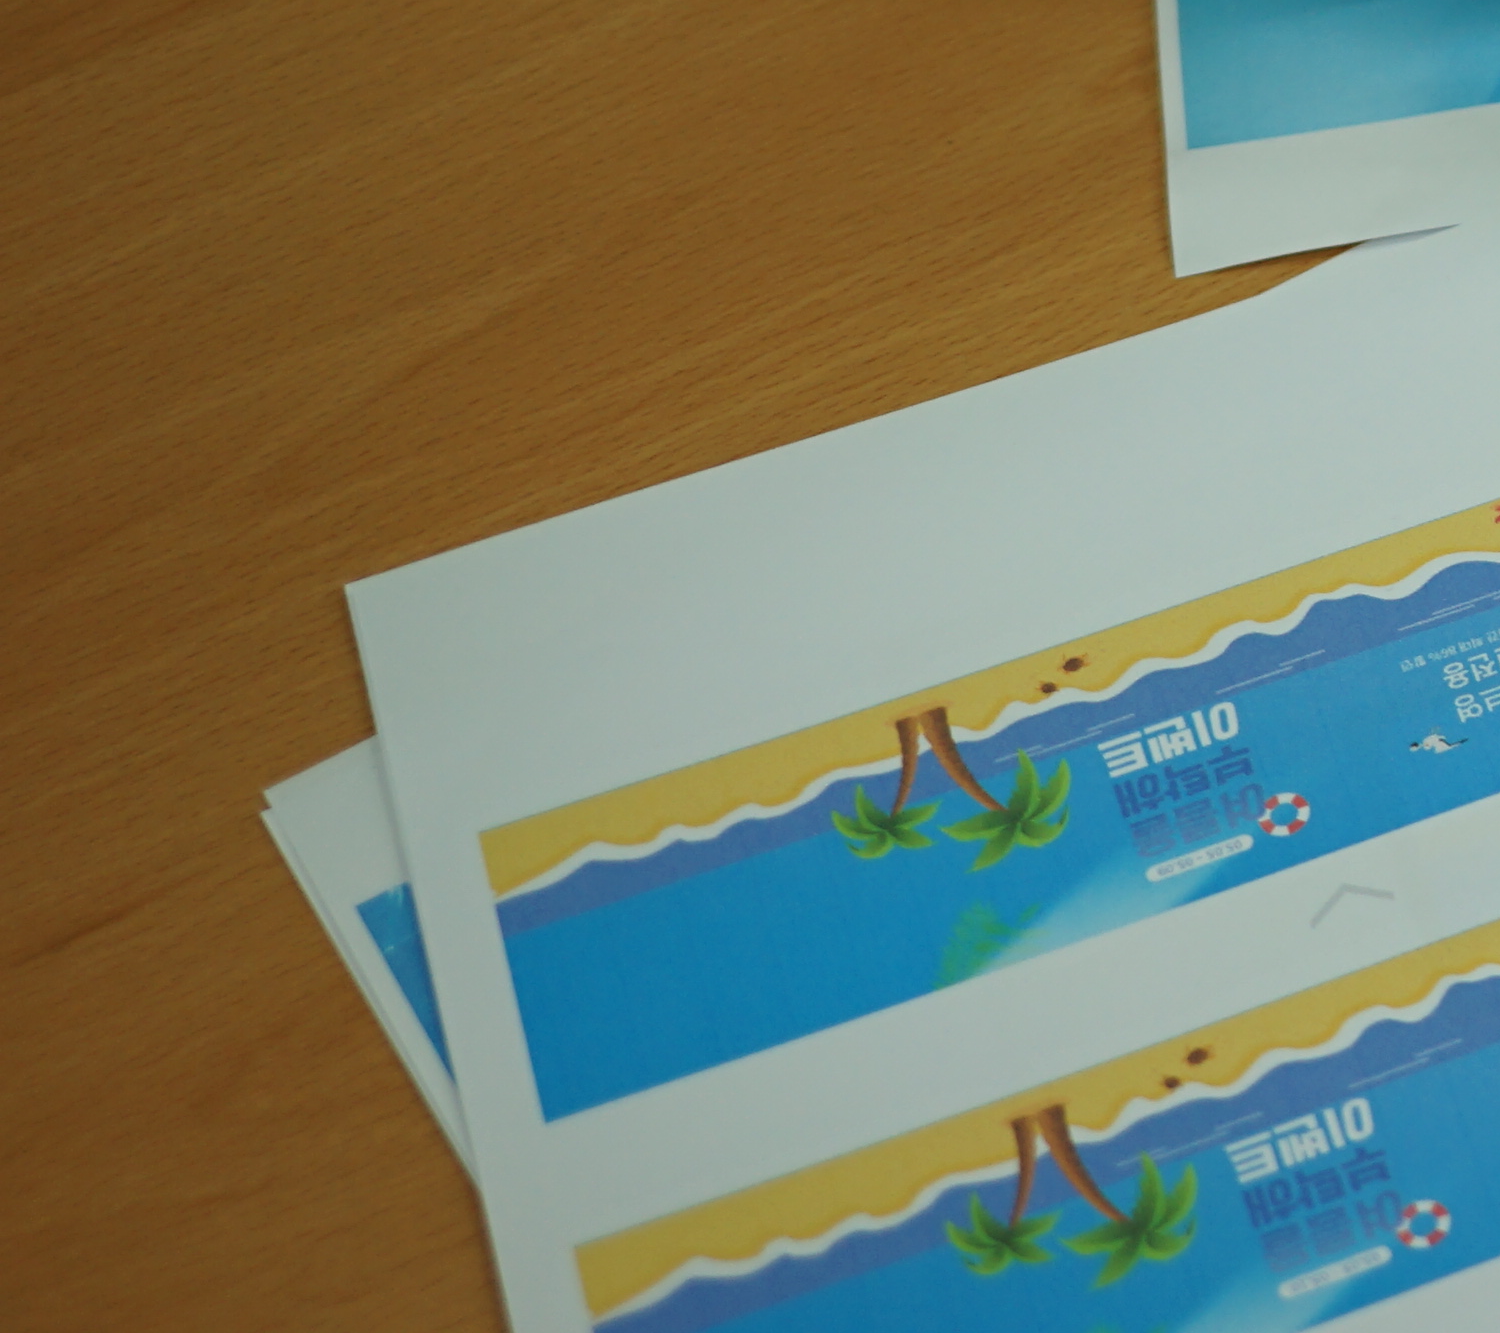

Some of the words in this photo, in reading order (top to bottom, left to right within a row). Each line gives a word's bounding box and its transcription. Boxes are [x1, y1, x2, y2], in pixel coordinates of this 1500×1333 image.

[1098, 701, 1240, 779] 이벤트
[1114, 744, 1252, 818] 부탁해
[1228, 1097, 1374, 1183] 이벤트
